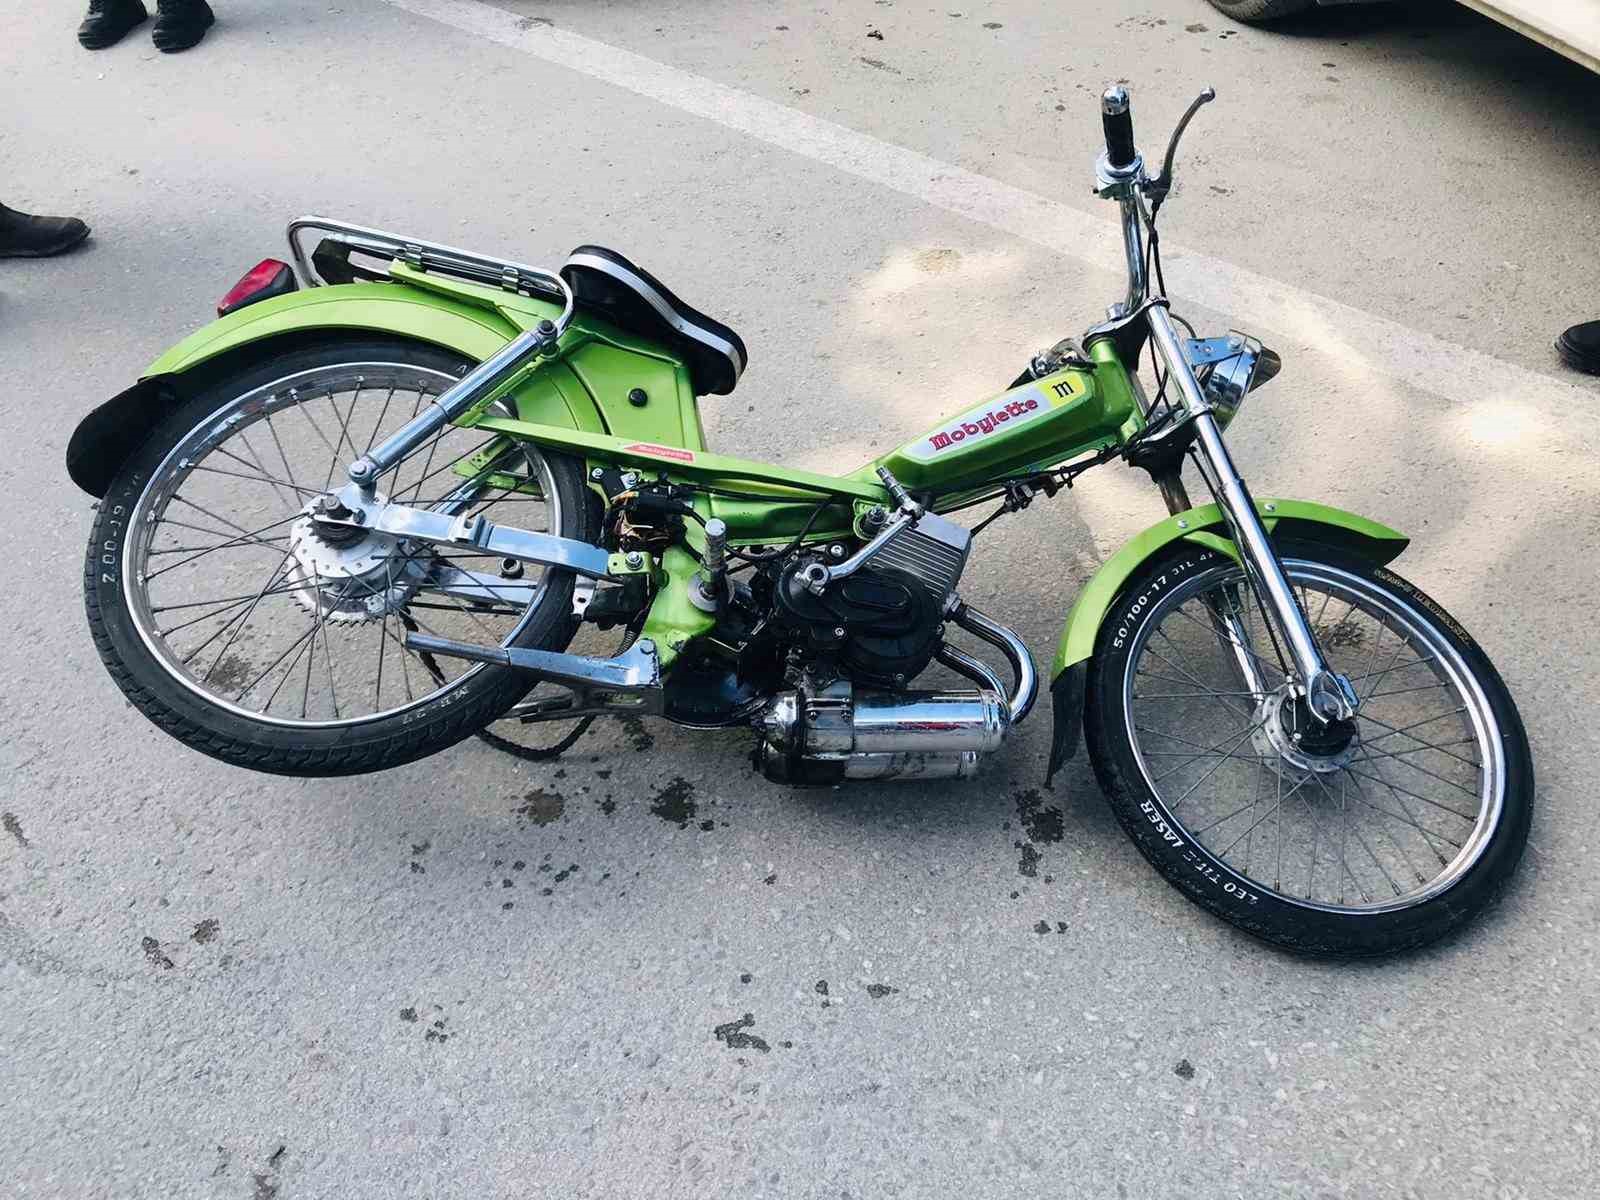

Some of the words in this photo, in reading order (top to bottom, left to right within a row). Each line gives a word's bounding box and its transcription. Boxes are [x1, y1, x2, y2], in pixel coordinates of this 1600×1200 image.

[928, 398, 1039, 451] Mobylette
[1112, 574, 1169, 650] 50/100-17
[1140, 799, 1185, 848] LASER
